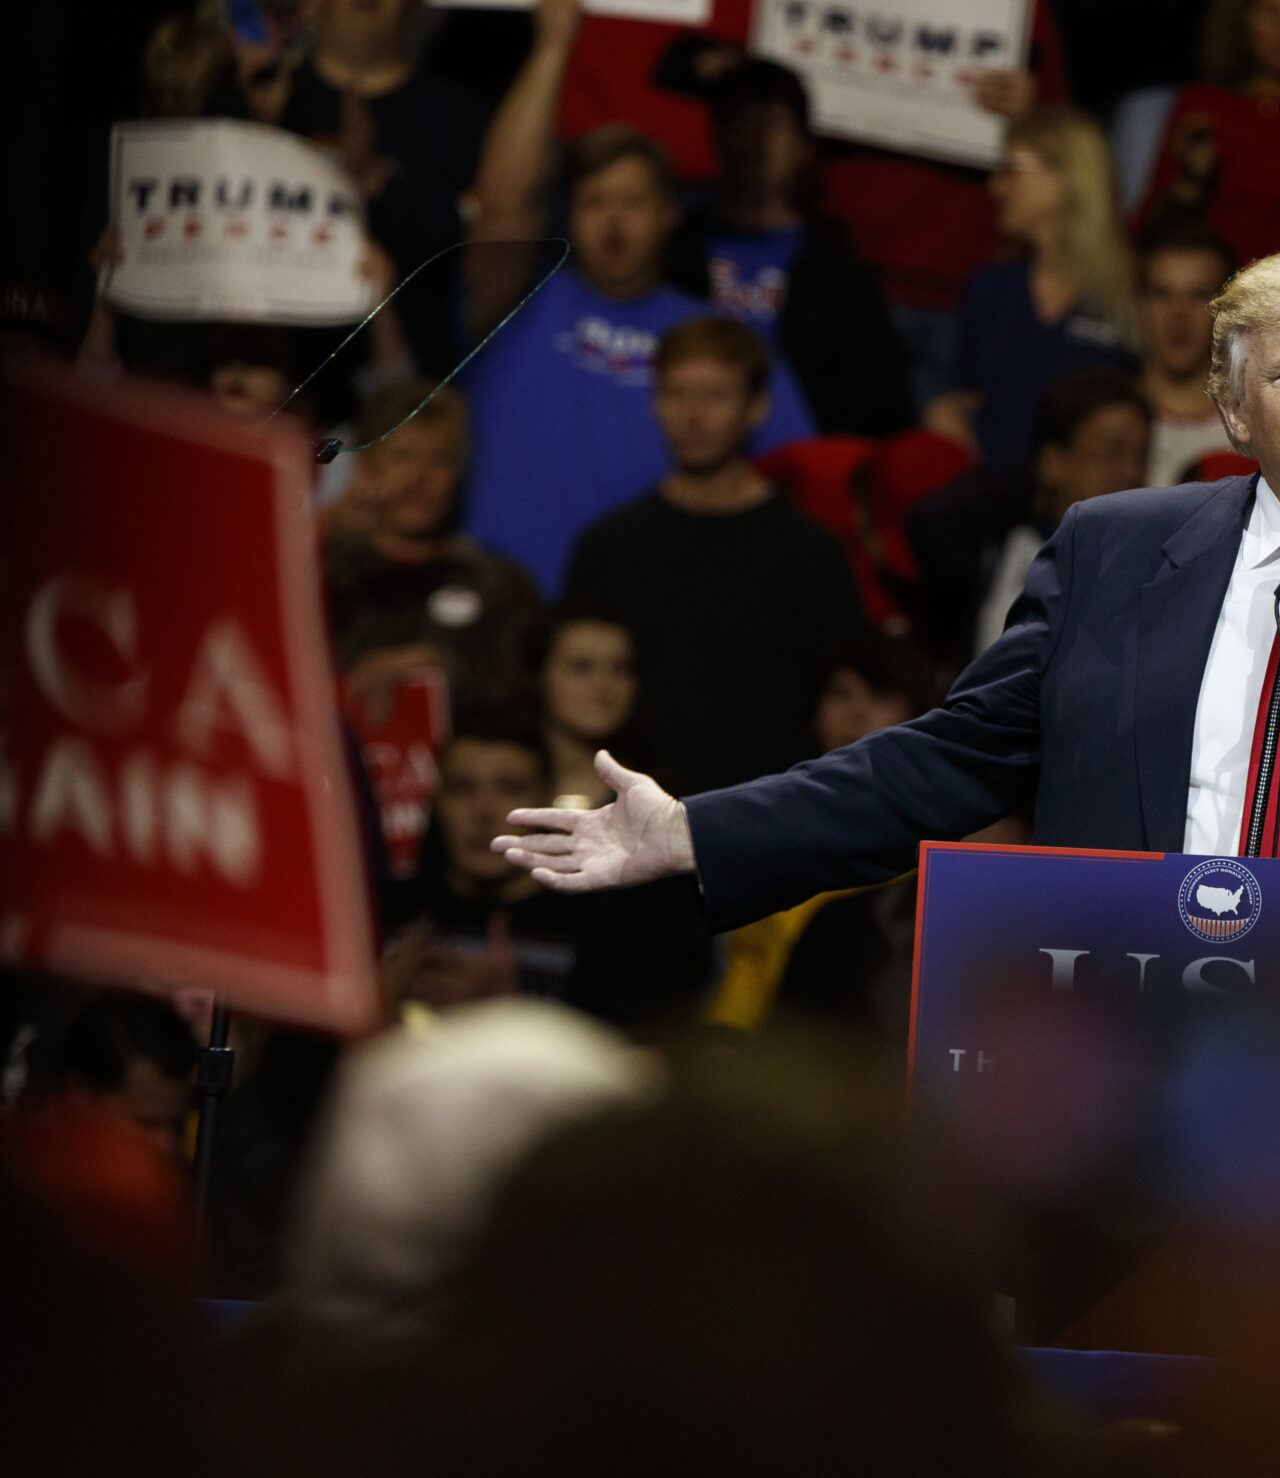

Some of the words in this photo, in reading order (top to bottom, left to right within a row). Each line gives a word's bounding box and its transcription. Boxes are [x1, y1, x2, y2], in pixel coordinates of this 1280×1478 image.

[0, 730, 263, 889] AIN
[1187, 874, 1204, 902] PRESIDENT
[1220, 868, 1242, 879] DONALD
[1245, 882, 1253, 905] TRUMP
